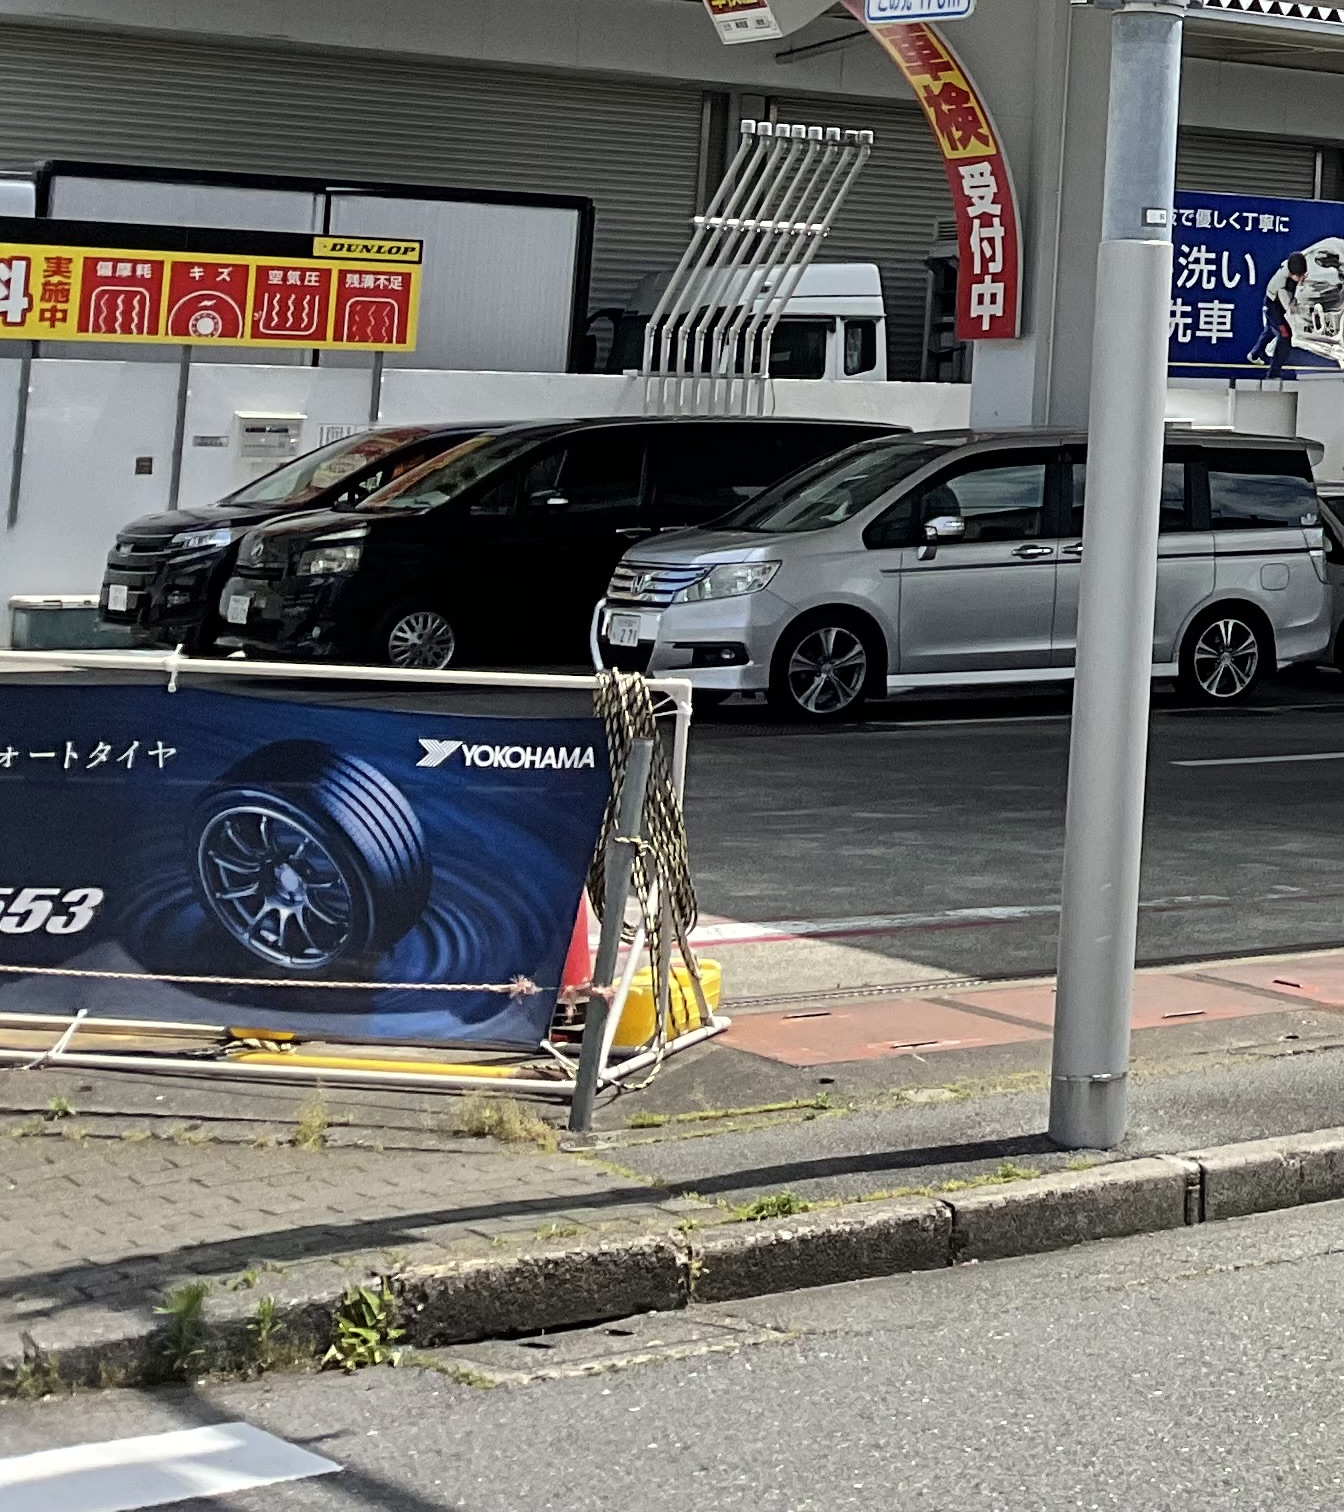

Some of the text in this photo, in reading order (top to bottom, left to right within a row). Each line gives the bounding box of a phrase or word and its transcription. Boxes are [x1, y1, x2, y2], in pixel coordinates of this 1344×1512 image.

[330, 241, 418, 257] DUNLOP
[267, 269, 321, 287] 空気圧
[1176, 244, 1256, 290] 洗い
[38, 256, 74, 329] 実施中
[462, 744, 595, 770] YOKOHAMA
